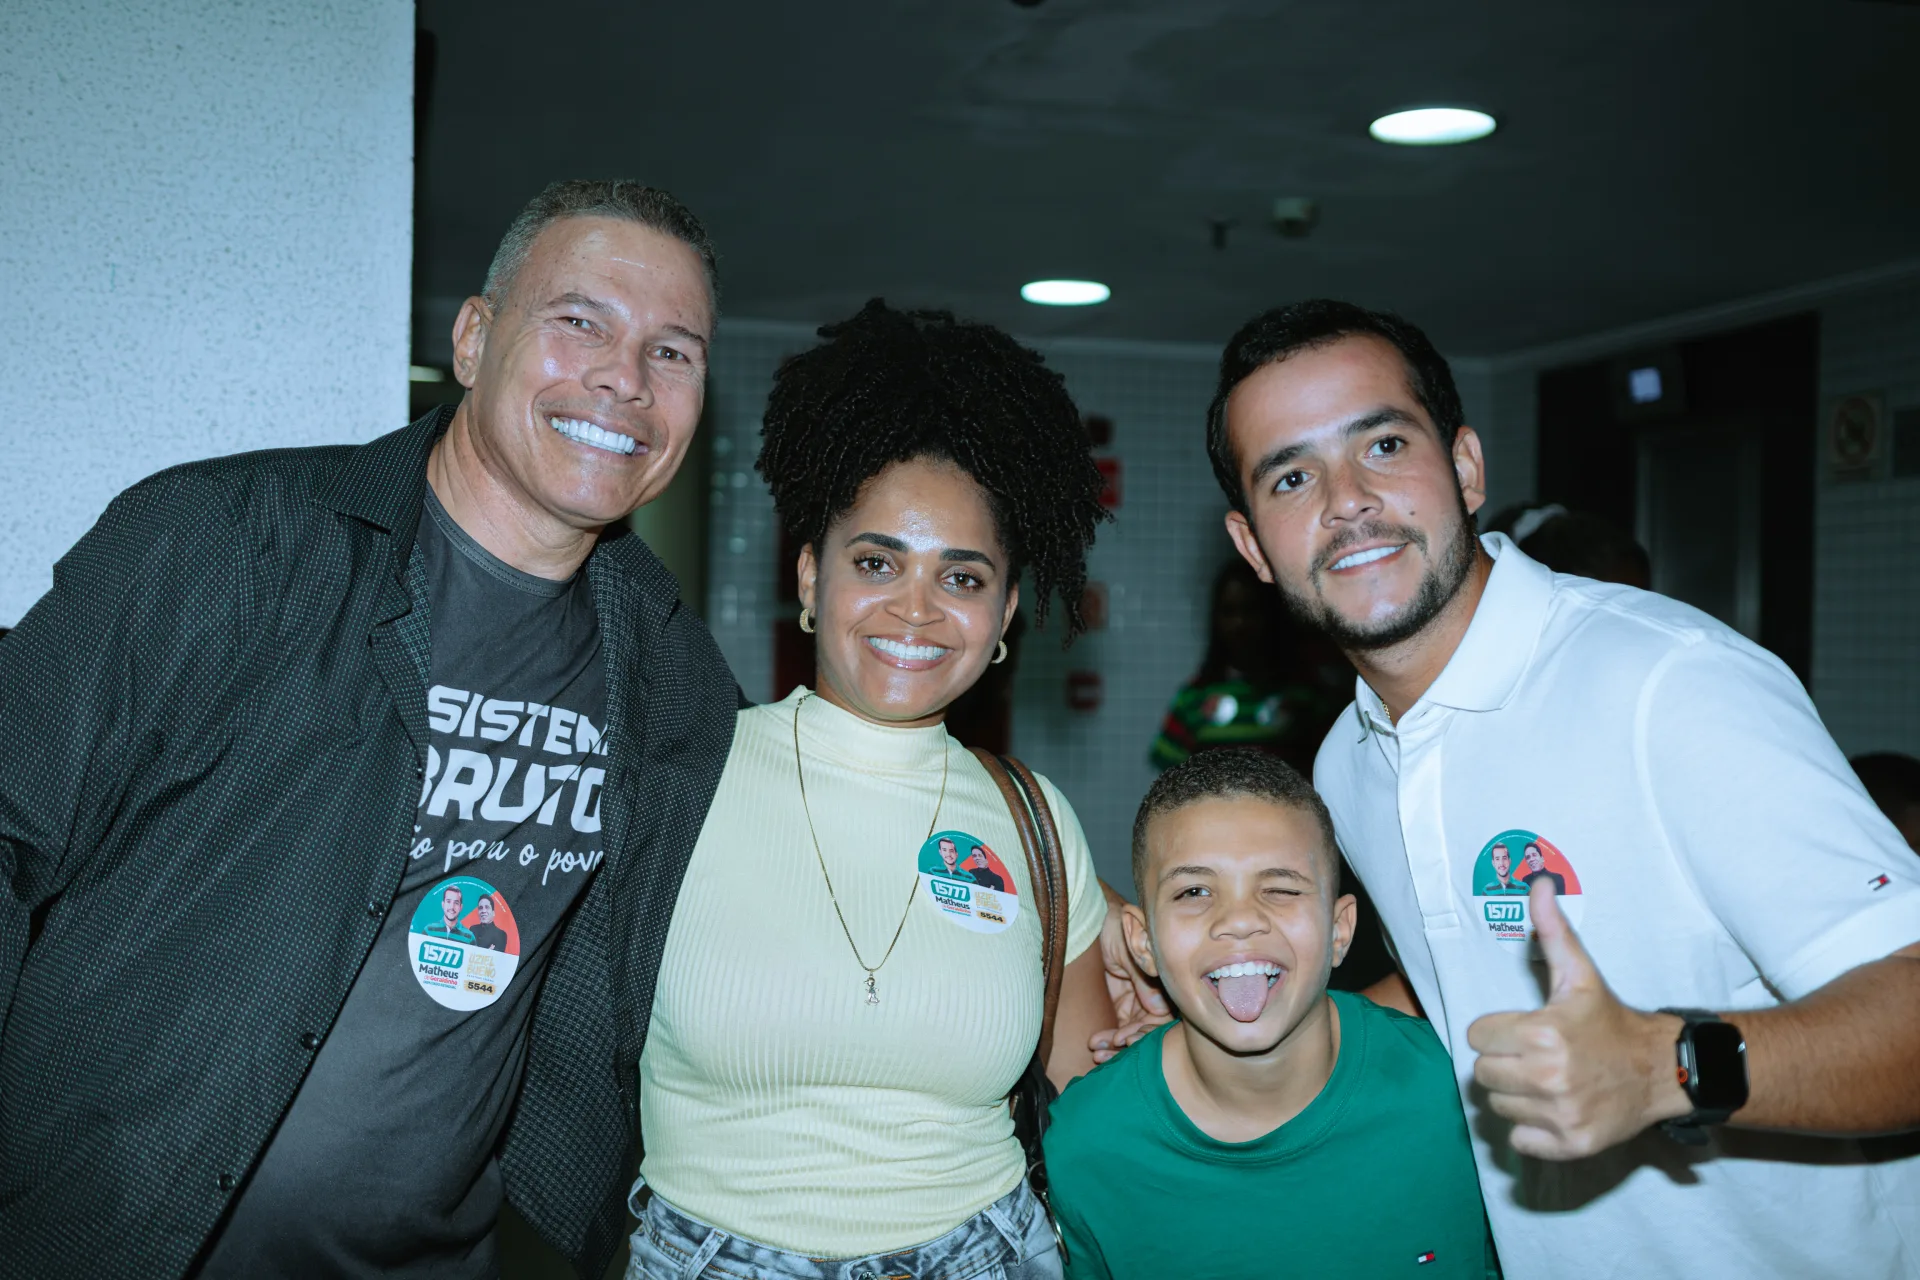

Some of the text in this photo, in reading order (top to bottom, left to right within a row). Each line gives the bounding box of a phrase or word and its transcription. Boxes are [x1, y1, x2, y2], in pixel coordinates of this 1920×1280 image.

[519, 843, 540, 866] o
[933, 881, 968, 899] 15777
[935, 896, 971, 910] Matheus
[1486, 903, 1521, 919] 15777
[980, 912, 1003, 923] 5544
[1489, 923, 1524, 932] Matheus
[423, 944, 461, 966] 15777
[419, 964, 459, 980] Matheus
[468, 982, 493, 993] 5544
